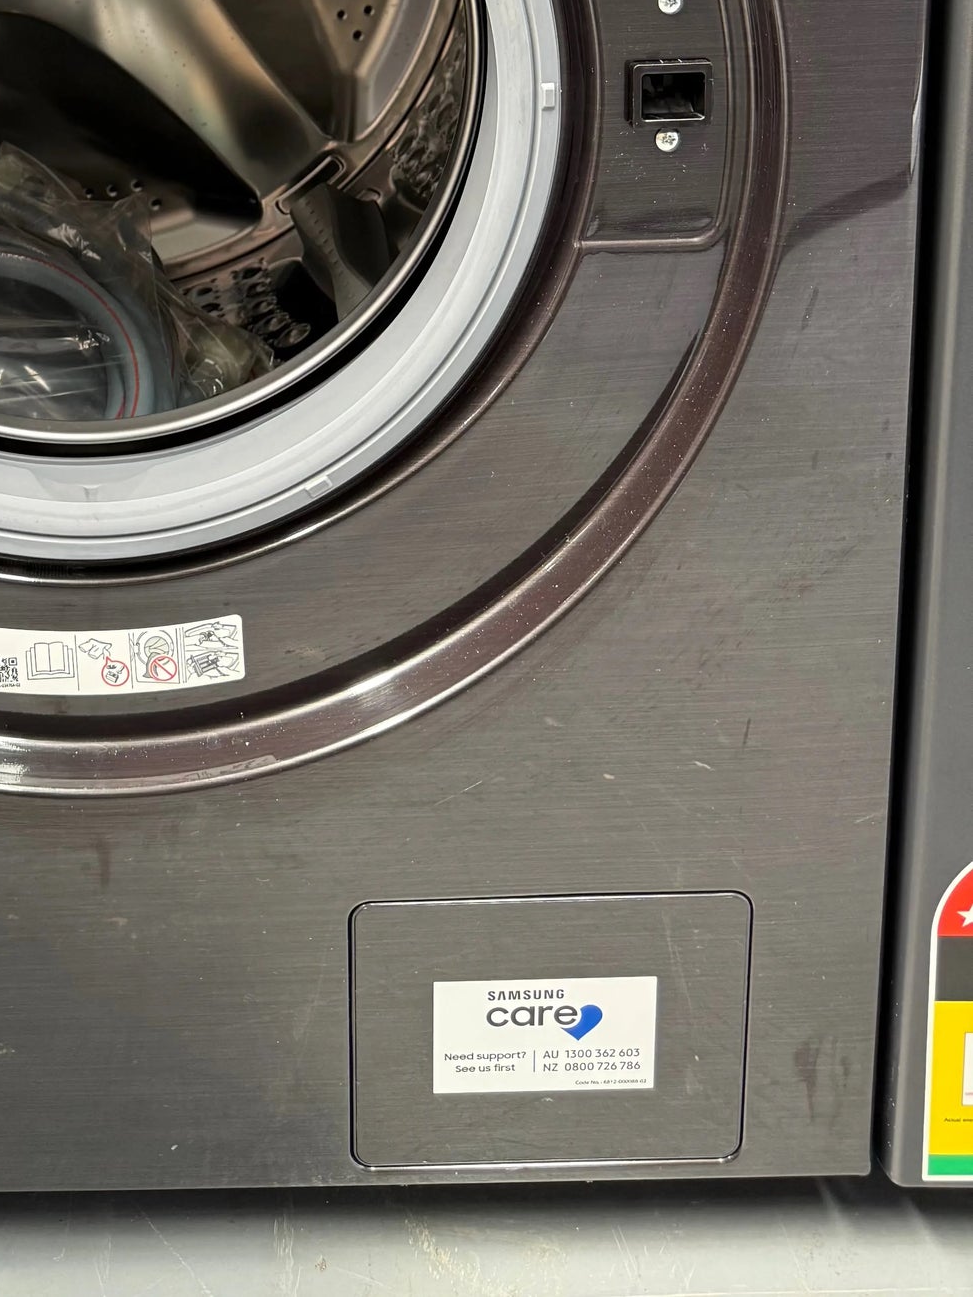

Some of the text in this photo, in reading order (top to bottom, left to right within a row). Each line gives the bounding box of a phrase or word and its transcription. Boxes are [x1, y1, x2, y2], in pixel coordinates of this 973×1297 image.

[487, 988, 565, 1001] SAMSUNG
[486, 1004, 578, 1027] care
[444, 1051, 527, 1062] Need support?
[543, 1048, 640, 1059] AU 1300 362 603
[455, 1063, 516, 1073] See us first
[543, 1060, 641, 1072] NZ 0800 726 786
